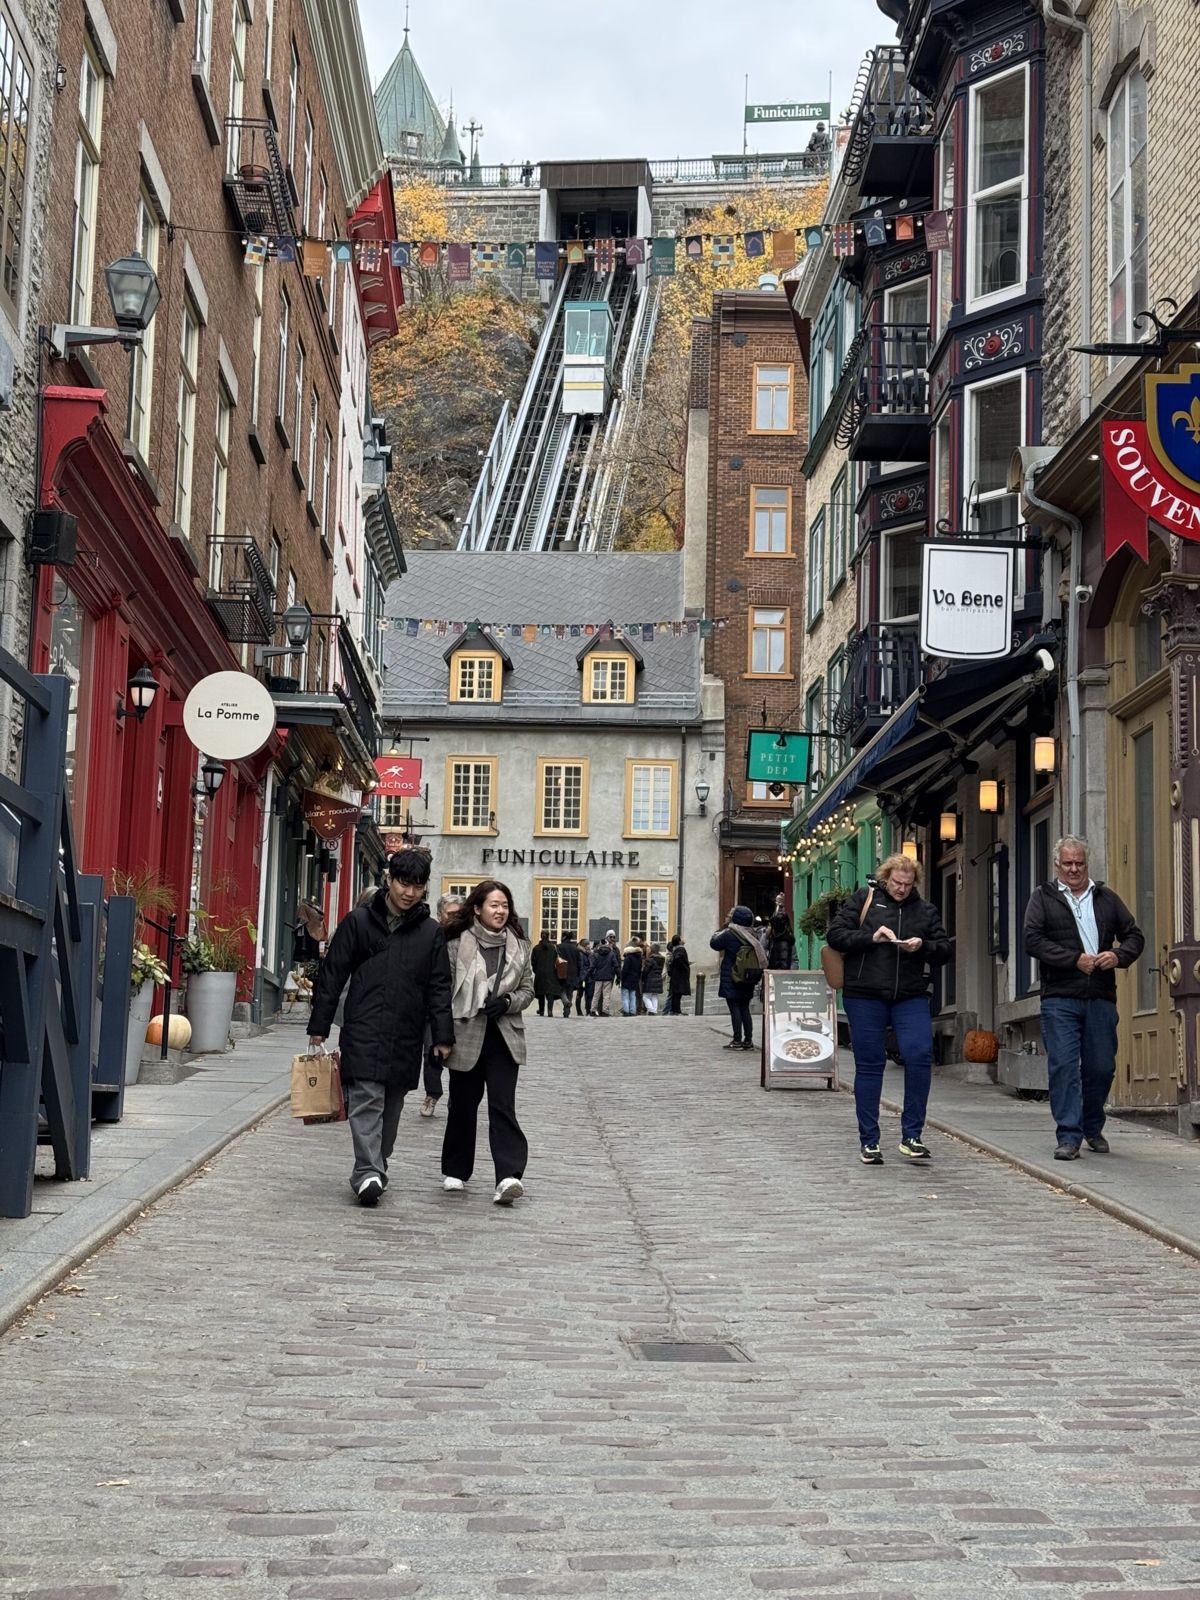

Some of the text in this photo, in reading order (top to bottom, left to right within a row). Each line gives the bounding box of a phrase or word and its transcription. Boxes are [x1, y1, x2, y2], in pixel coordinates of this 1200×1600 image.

[753, 104, 822, 119] Funiculaire
[932, 589, 1004, 608] Va Bene
[197, 707, 260, 721] La Pomme
[760, 752, 796, 764] PETIT
[767, 765, 788, 775] DEP
[482, 849, 640, 867] FUNICULAIRE
